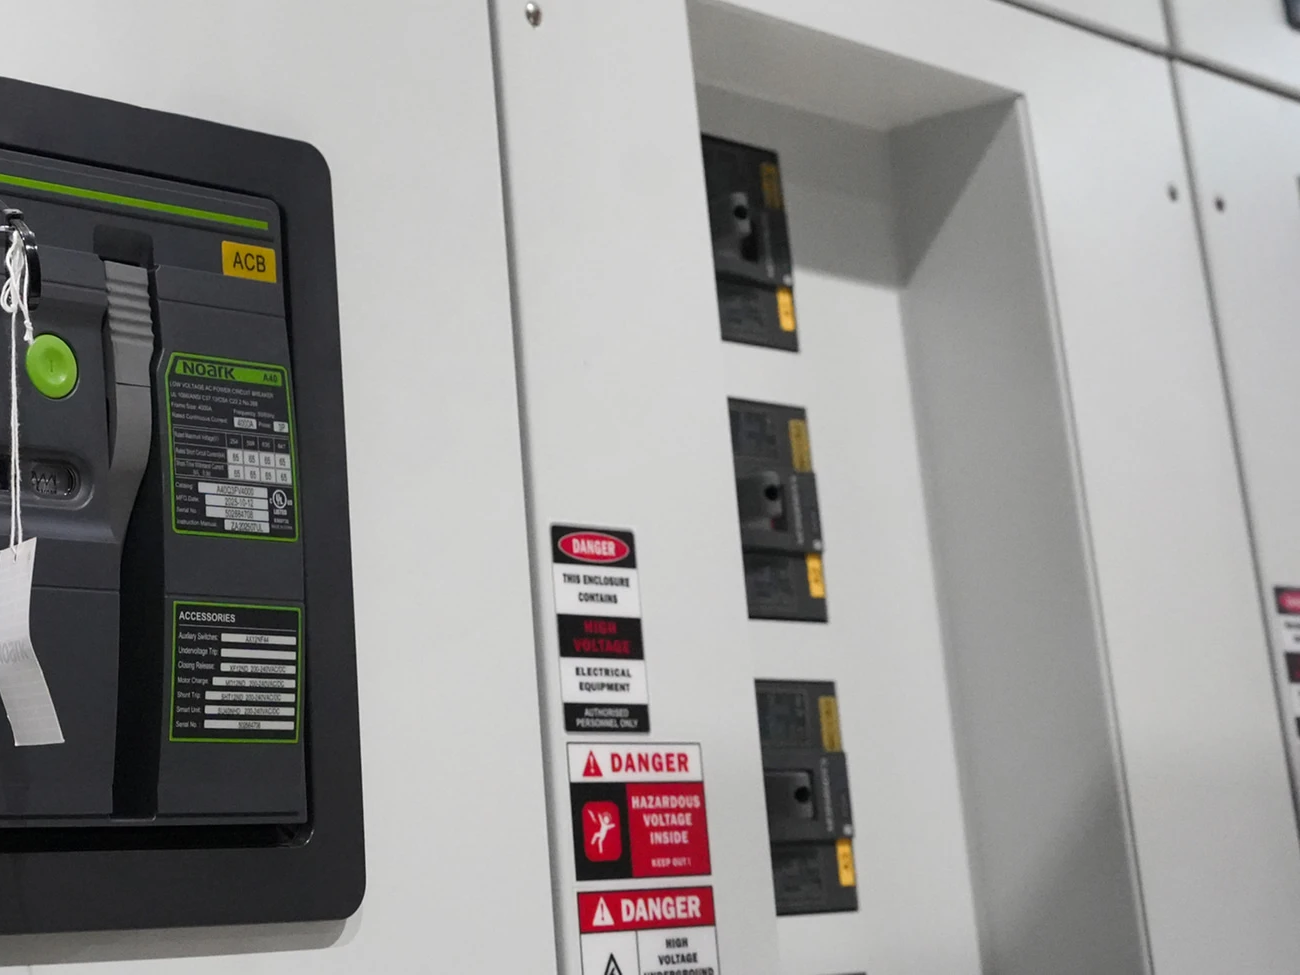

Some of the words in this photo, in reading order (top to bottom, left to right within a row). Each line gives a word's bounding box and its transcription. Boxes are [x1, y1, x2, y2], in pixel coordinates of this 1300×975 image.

[233, 251, 266, 273] ACB
[263, 373, 278, 384] A40
[572, 538, 616, 557] DANGER
[563, 573, 580, 584] THIS
[583, 575, 630, 588] ENCLOSURE
[578, 592, 618, 604] CONTAINS
[179, 611, 236, 623] ACCESSORIES
[584, 620, 617, 634] HIGH
[574, 638, 631, 654] VOLTAGE
[575, 667, 632, 678] ELECTRICAL
[579, 682, 630, 693] EQUIPMENT
[584, 708, 629, 718] AUTHORISED
[576, 718, 618, 728] PERSONNEL
[619, 718, 638, 728] ONLY
[610, 752, 690, 773] DANGER
[631, 796, 700, 809] HAZARDOUS
[643, 813, 692, 827] VOLTAGE
[650, 831, 689, 845] INSIDE
[651, 858, 670, 868] KEEP
[620, 896, 702, 923] DANGER
[666, 938, 688, 949] HIGH
[658, 952, 698, 965] VOLTAGE
